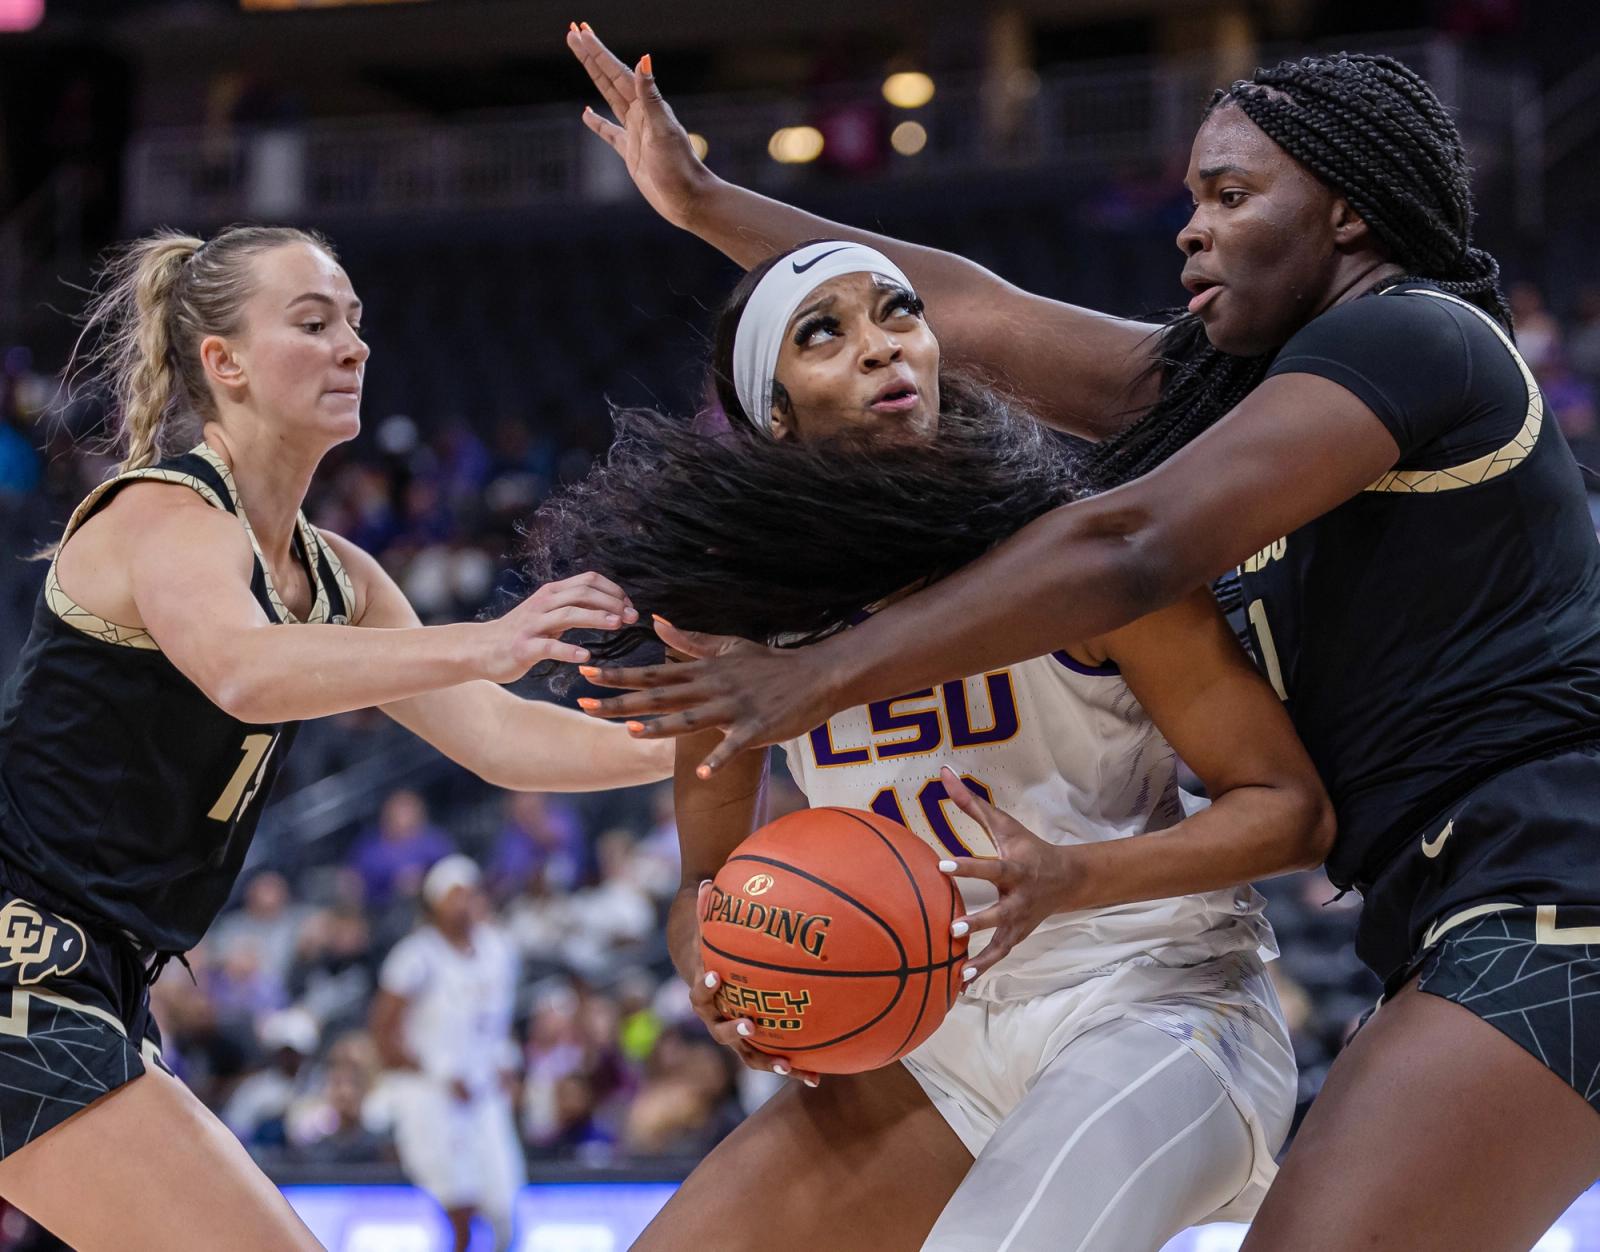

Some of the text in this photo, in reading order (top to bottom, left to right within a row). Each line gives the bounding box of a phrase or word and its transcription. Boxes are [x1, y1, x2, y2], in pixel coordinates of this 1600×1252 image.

[808, 668, 1022, 770] LSU
[206, 732, 281, 823] 1
[716, 981, 811, 1015] GACY
